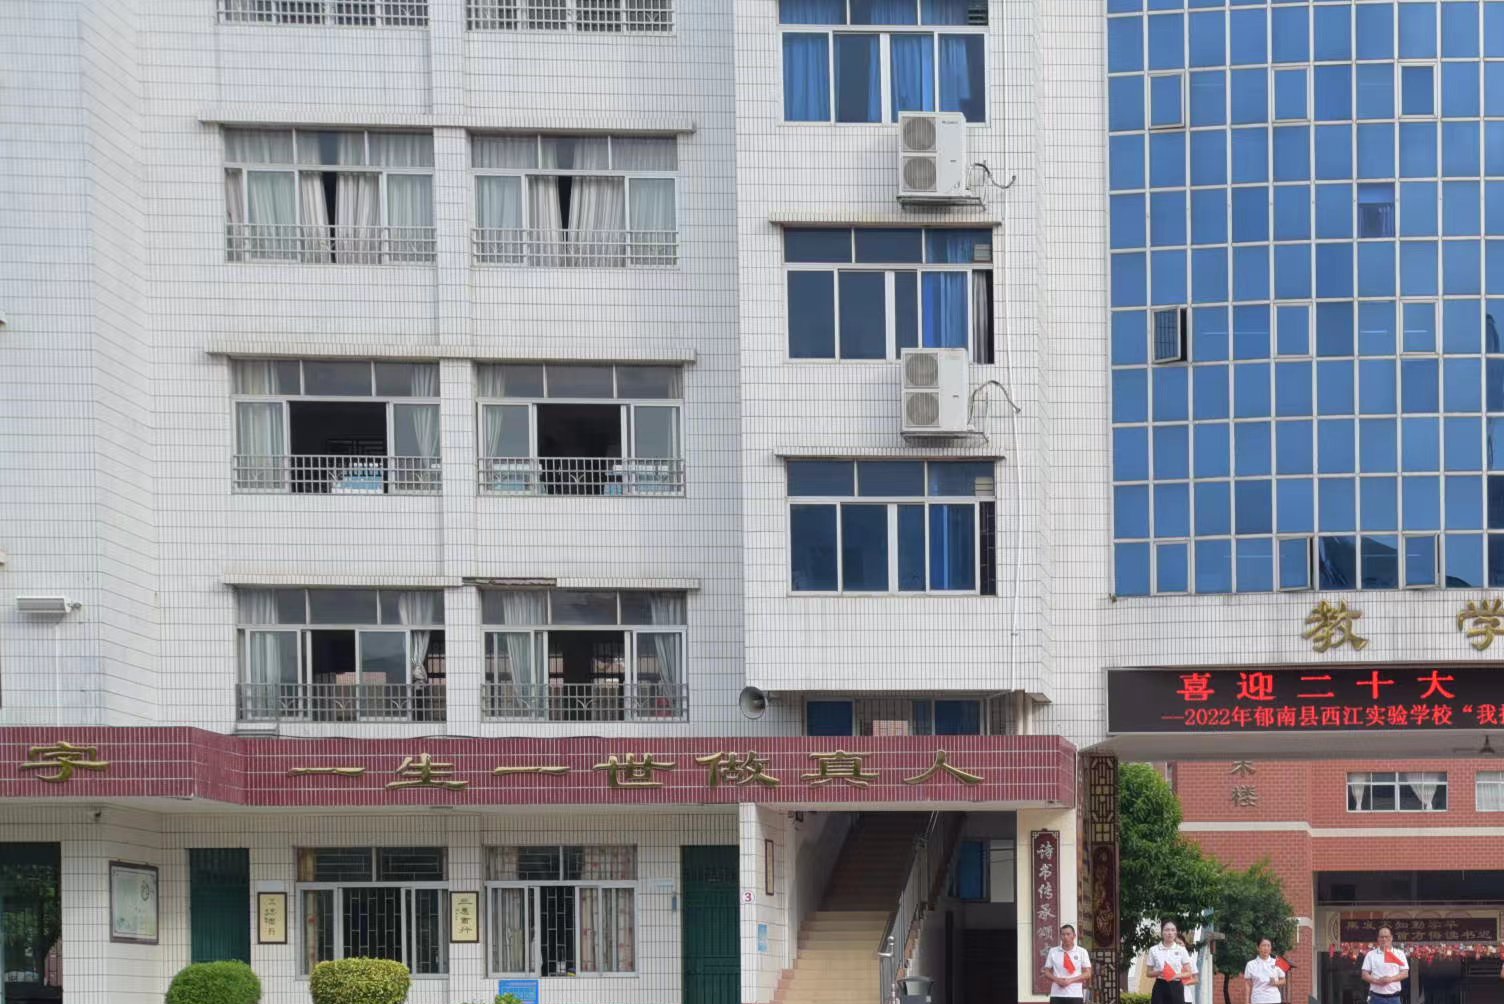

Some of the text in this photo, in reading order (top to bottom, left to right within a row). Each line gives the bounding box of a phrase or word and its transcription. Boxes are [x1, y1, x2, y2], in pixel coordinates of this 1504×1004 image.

[1176, 669, 1456, 701] 喜迎二十大
[20, 740, 110, 783] 字
[288, 749, 985, 791] 一生一世做真人
[744, 892, 752, 902] 3
